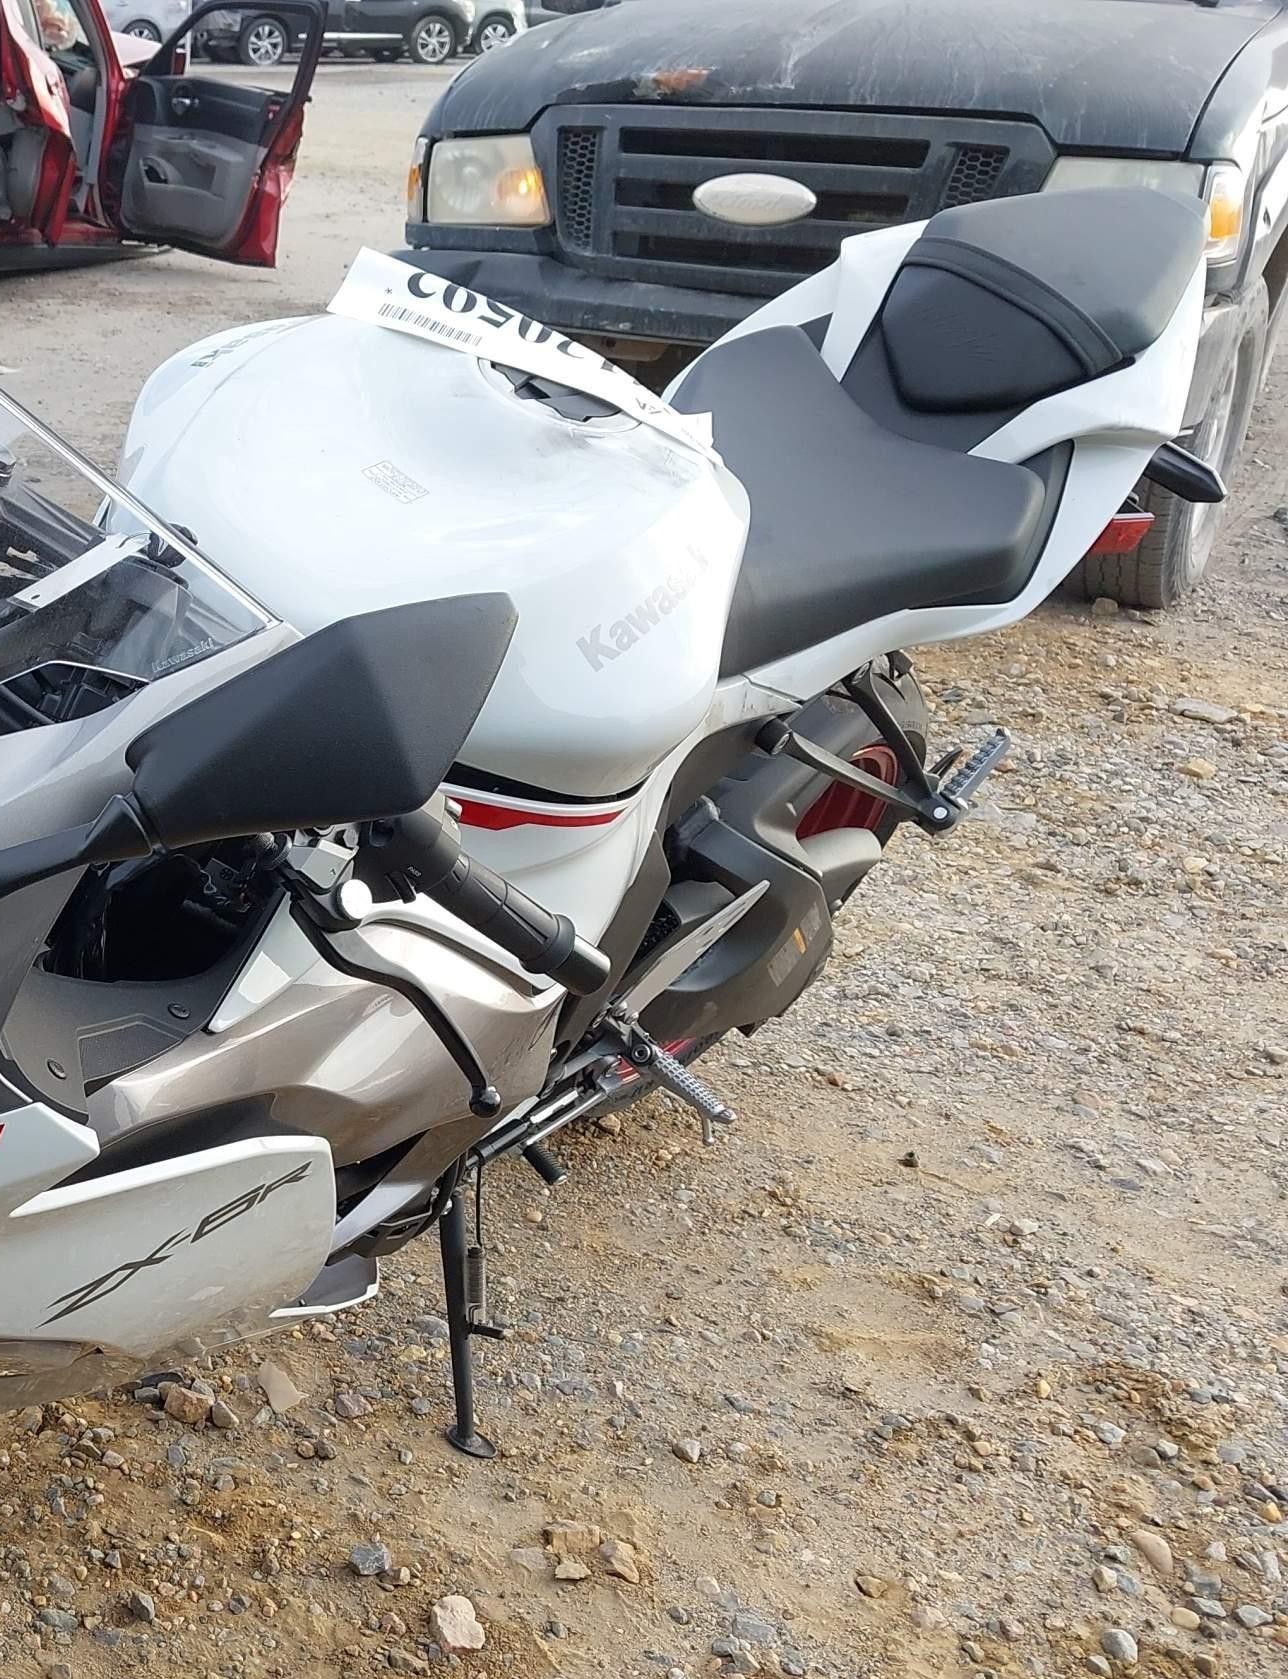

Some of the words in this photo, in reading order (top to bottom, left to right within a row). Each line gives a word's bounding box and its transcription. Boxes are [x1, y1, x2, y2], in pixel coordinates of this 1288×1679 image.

[151, 637, 215, 673] Kawasaki
[575, 543, 710, 673] Kawas
[35, 1160, 313, 1329] ZX-6R
